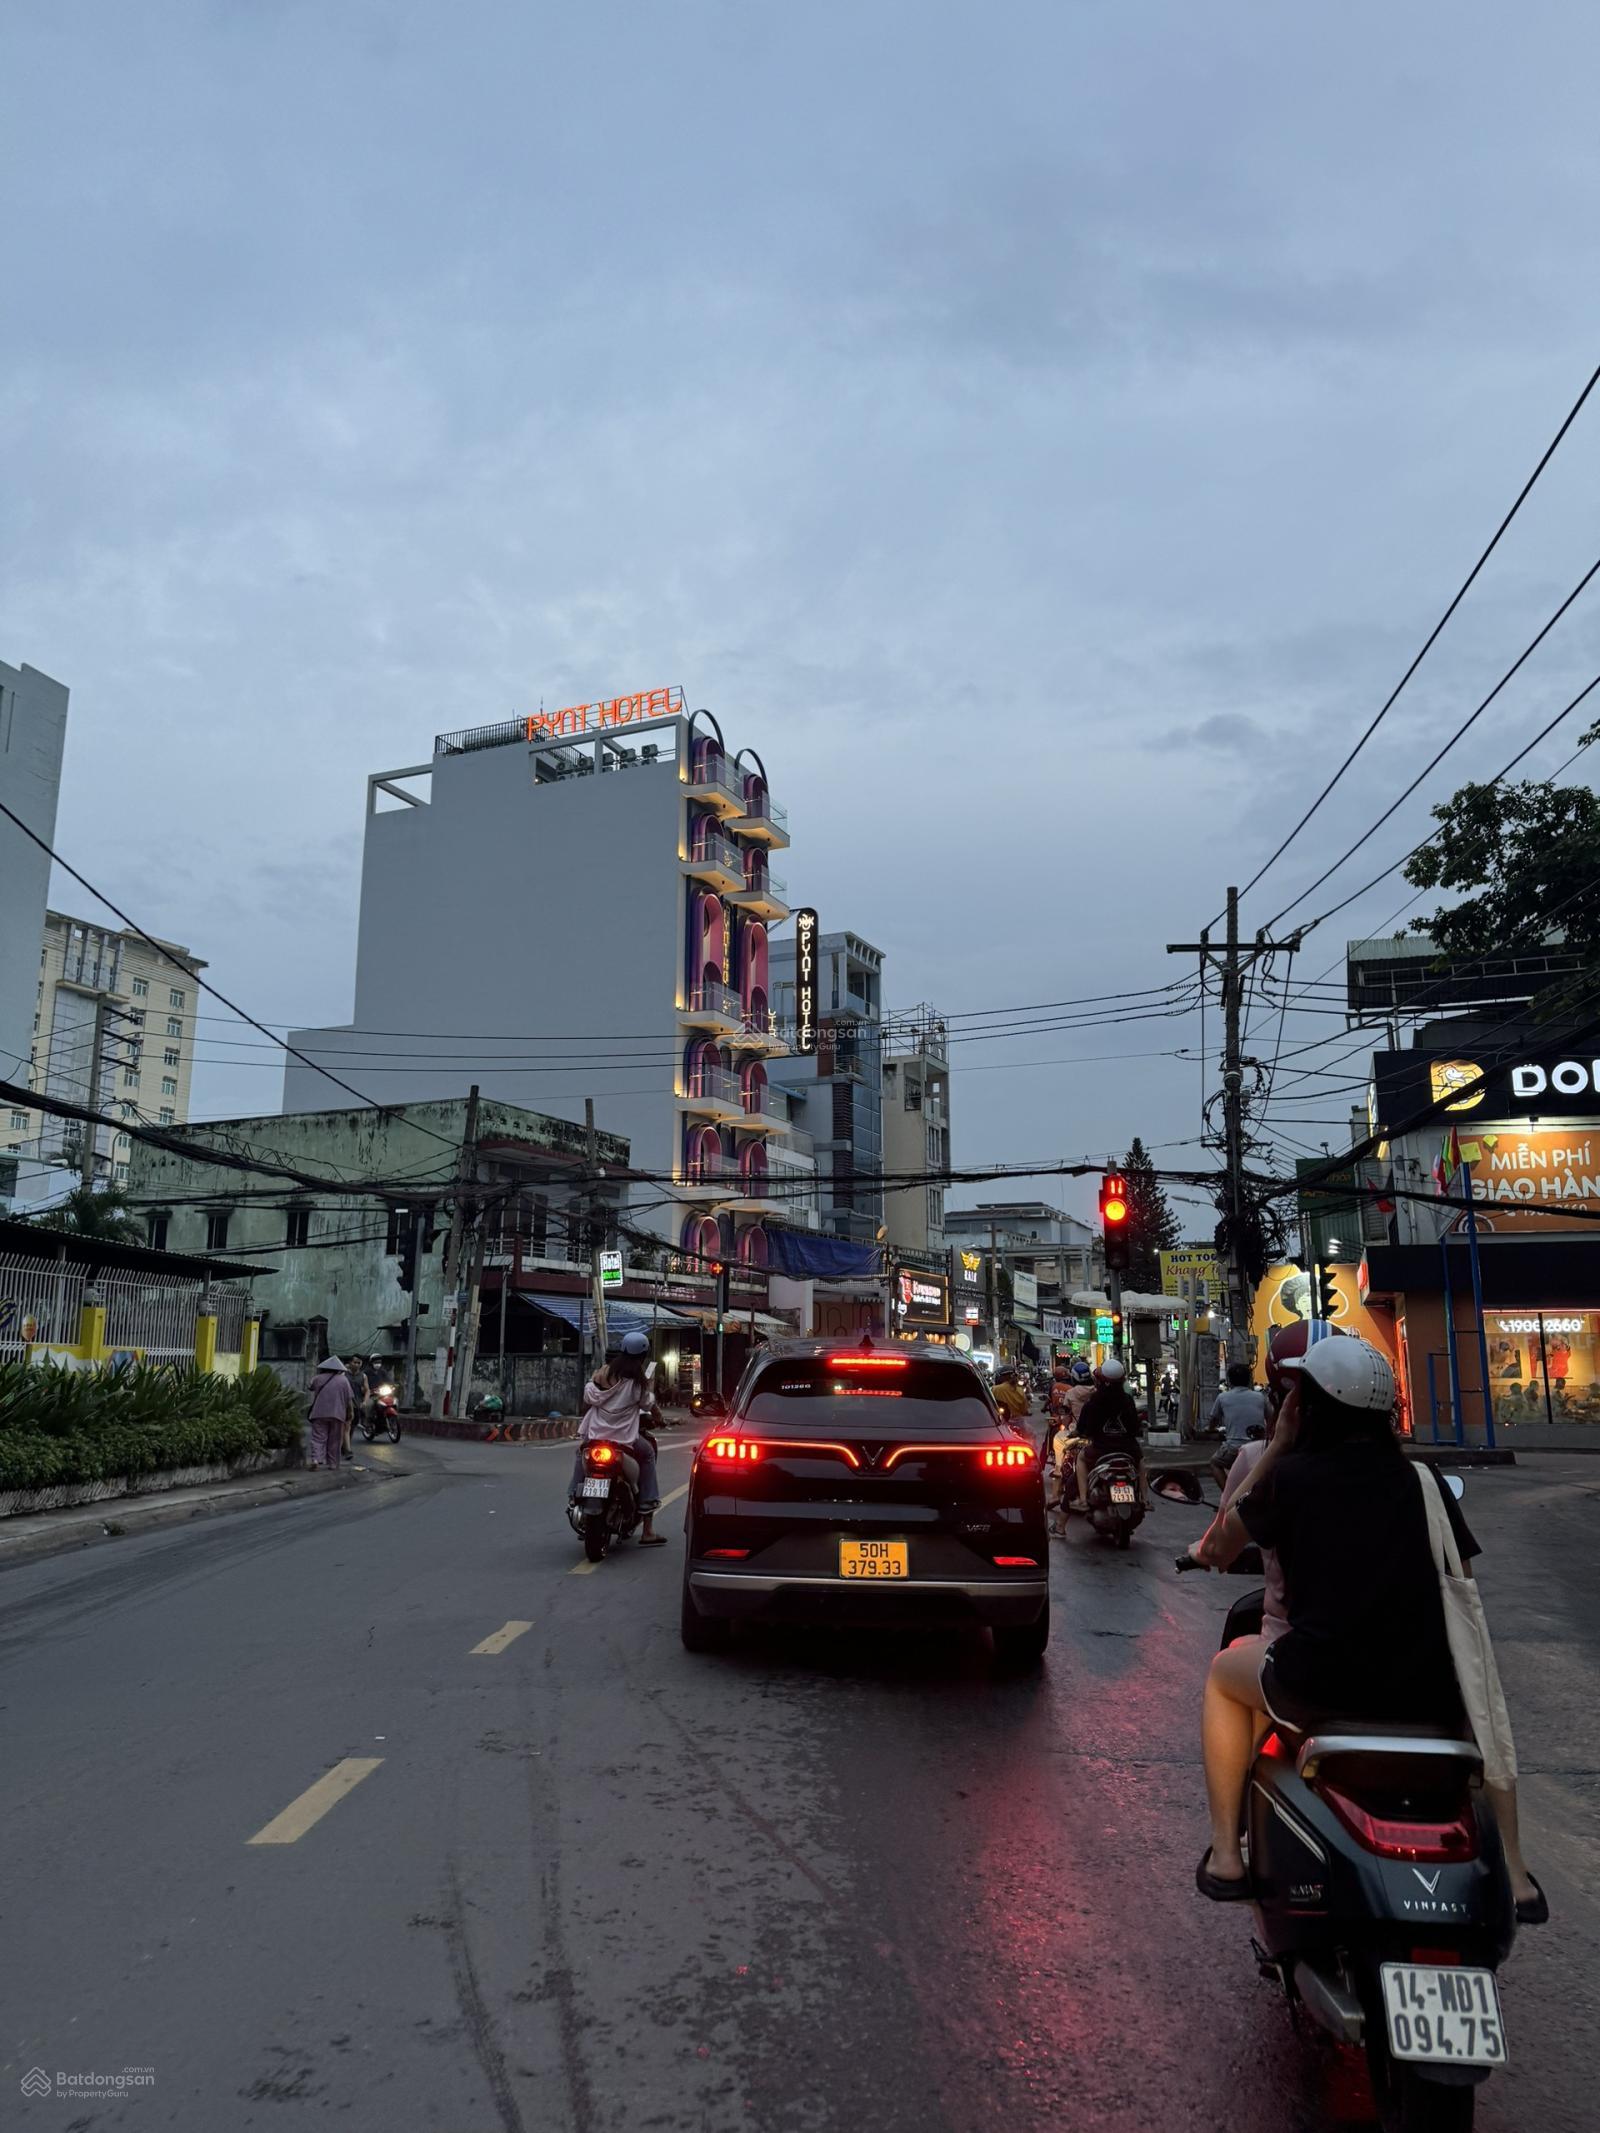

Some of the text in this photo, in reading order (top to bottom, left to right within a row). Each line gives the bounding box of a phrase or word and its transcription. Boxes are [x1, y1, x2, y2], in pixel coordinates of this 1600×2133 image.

[599, 687, 683, 728] HOTEL
[801, 986, 812, 1050] HOTEL
[1491, 1140, 1591, 1171] MIỄN PHÍ
[1471, 1177, 1536, 1201] GIAO
[859, 1543, 889, 1558] 50H
[847, 1560, 902, 1576] 379.33
[1403, 1900, 1468, 1913] VINFAST
[1394, 2014, 1501, 2058] 094.75
